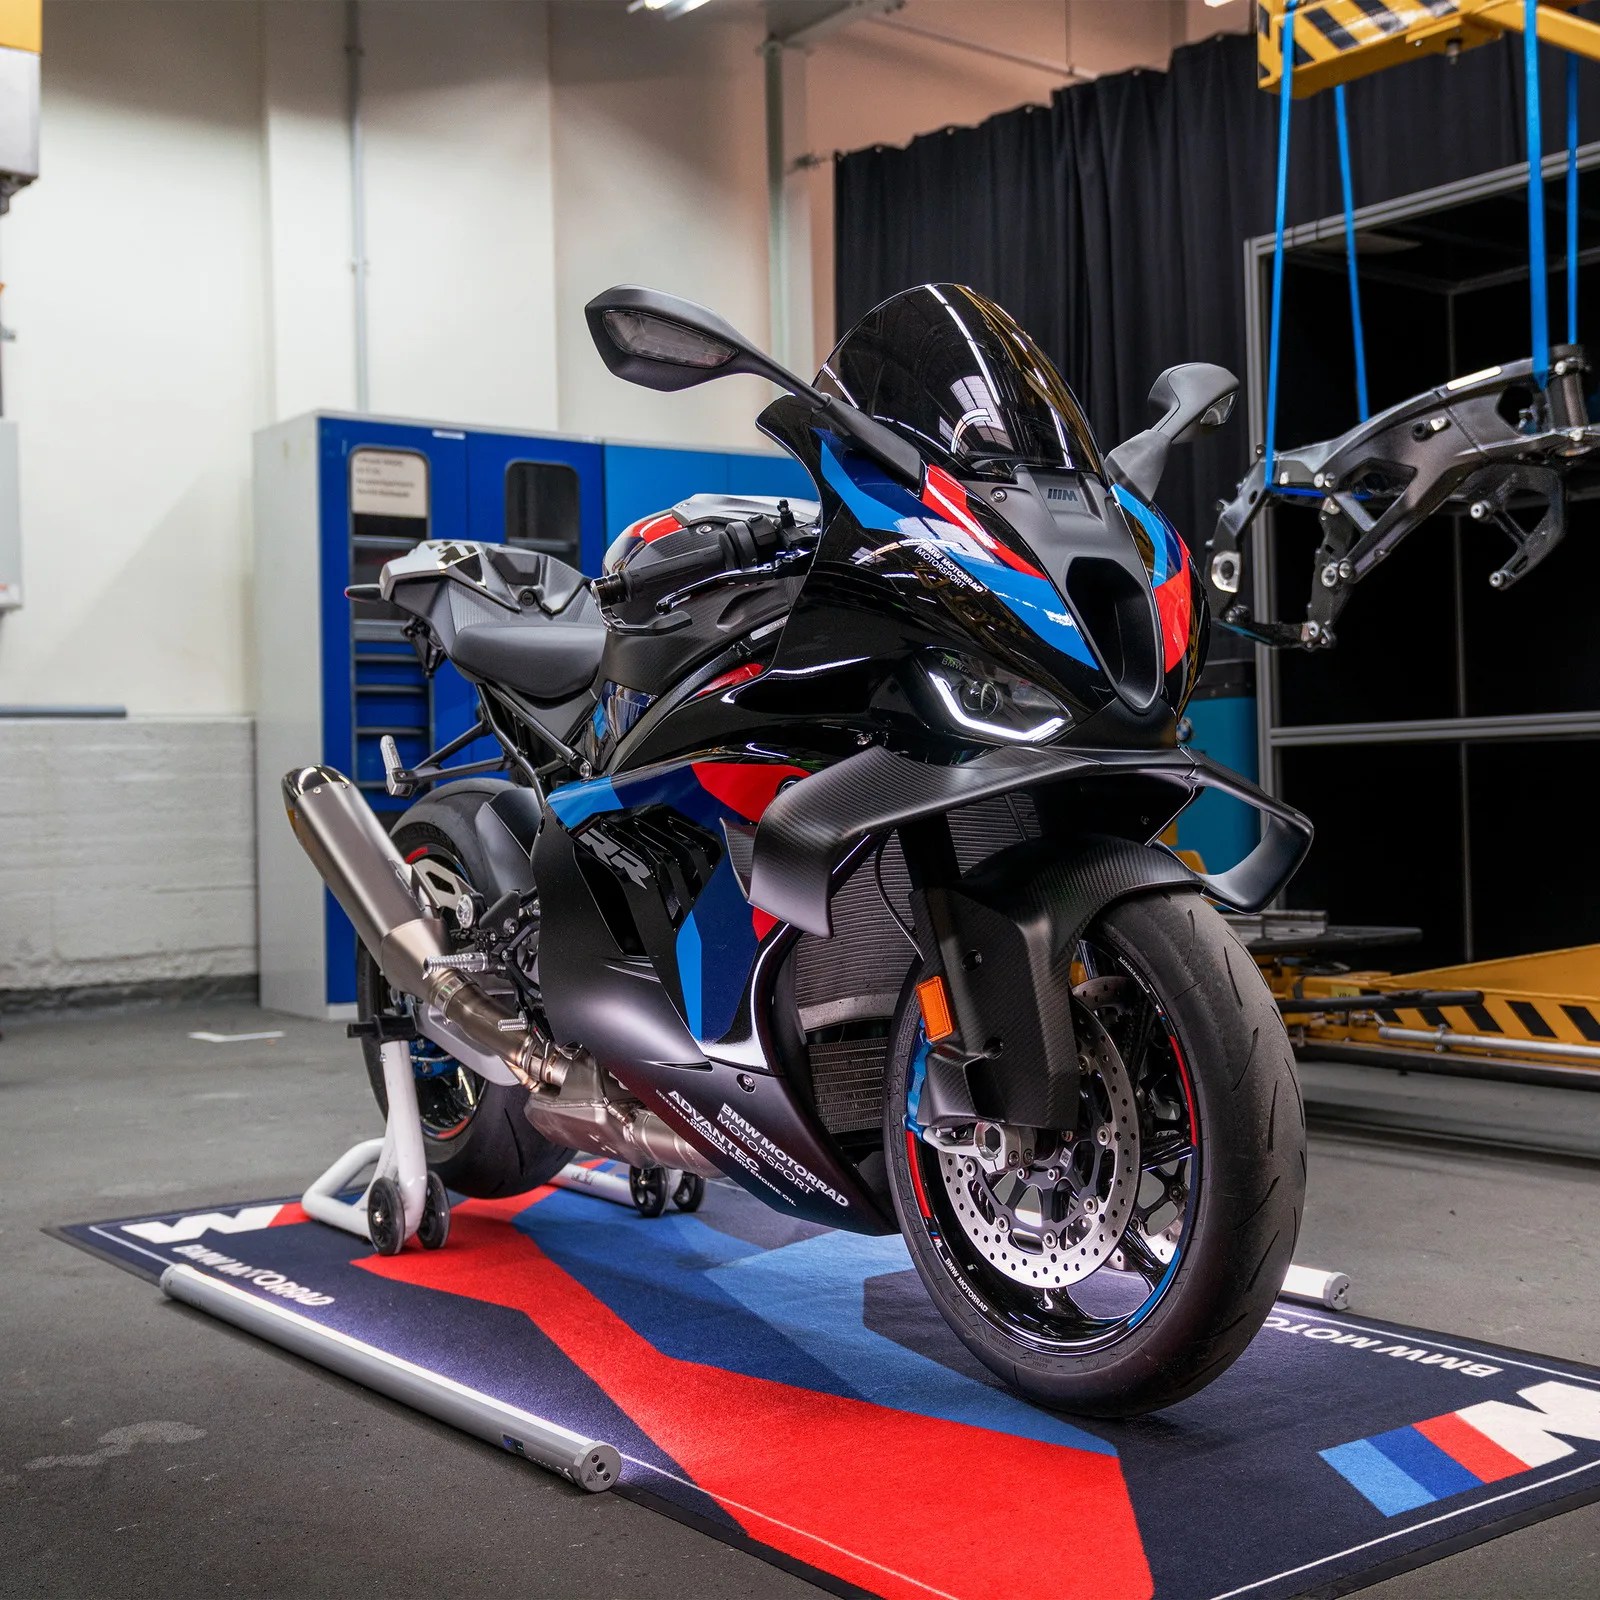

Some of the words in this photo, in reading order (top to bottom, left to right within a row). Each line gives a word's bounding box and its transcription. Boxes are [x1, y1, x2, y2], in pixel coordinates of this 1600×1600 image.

[914, 547, 967, 589] MOTORSPORT
[919, 541, 944, 560] BMW
[941, 558, 984, 593] MOTORRAD
[578, 828, 651, 889] RR
[668, 1090, 760, 1171] ADVANTEC
[716, 1113, 816, 1195] MOTORSPORT
[720, 1102, 762, 1140] BMW
[760, 1134, 849, 1207] MOTORRAD
[690, 1118, 728, 1152] ORIGINAL
[728, 1151, 750, 1169] BMW
[750, 1169, 782, 1195] ENGINE
[782, 1194, 797, 1207] OIL
[945, 1258, 960, 1278] BMW
[957, 1277, 988, 1312] MOTORRAD
[1371, 1345, 1503, 1378] BMW
